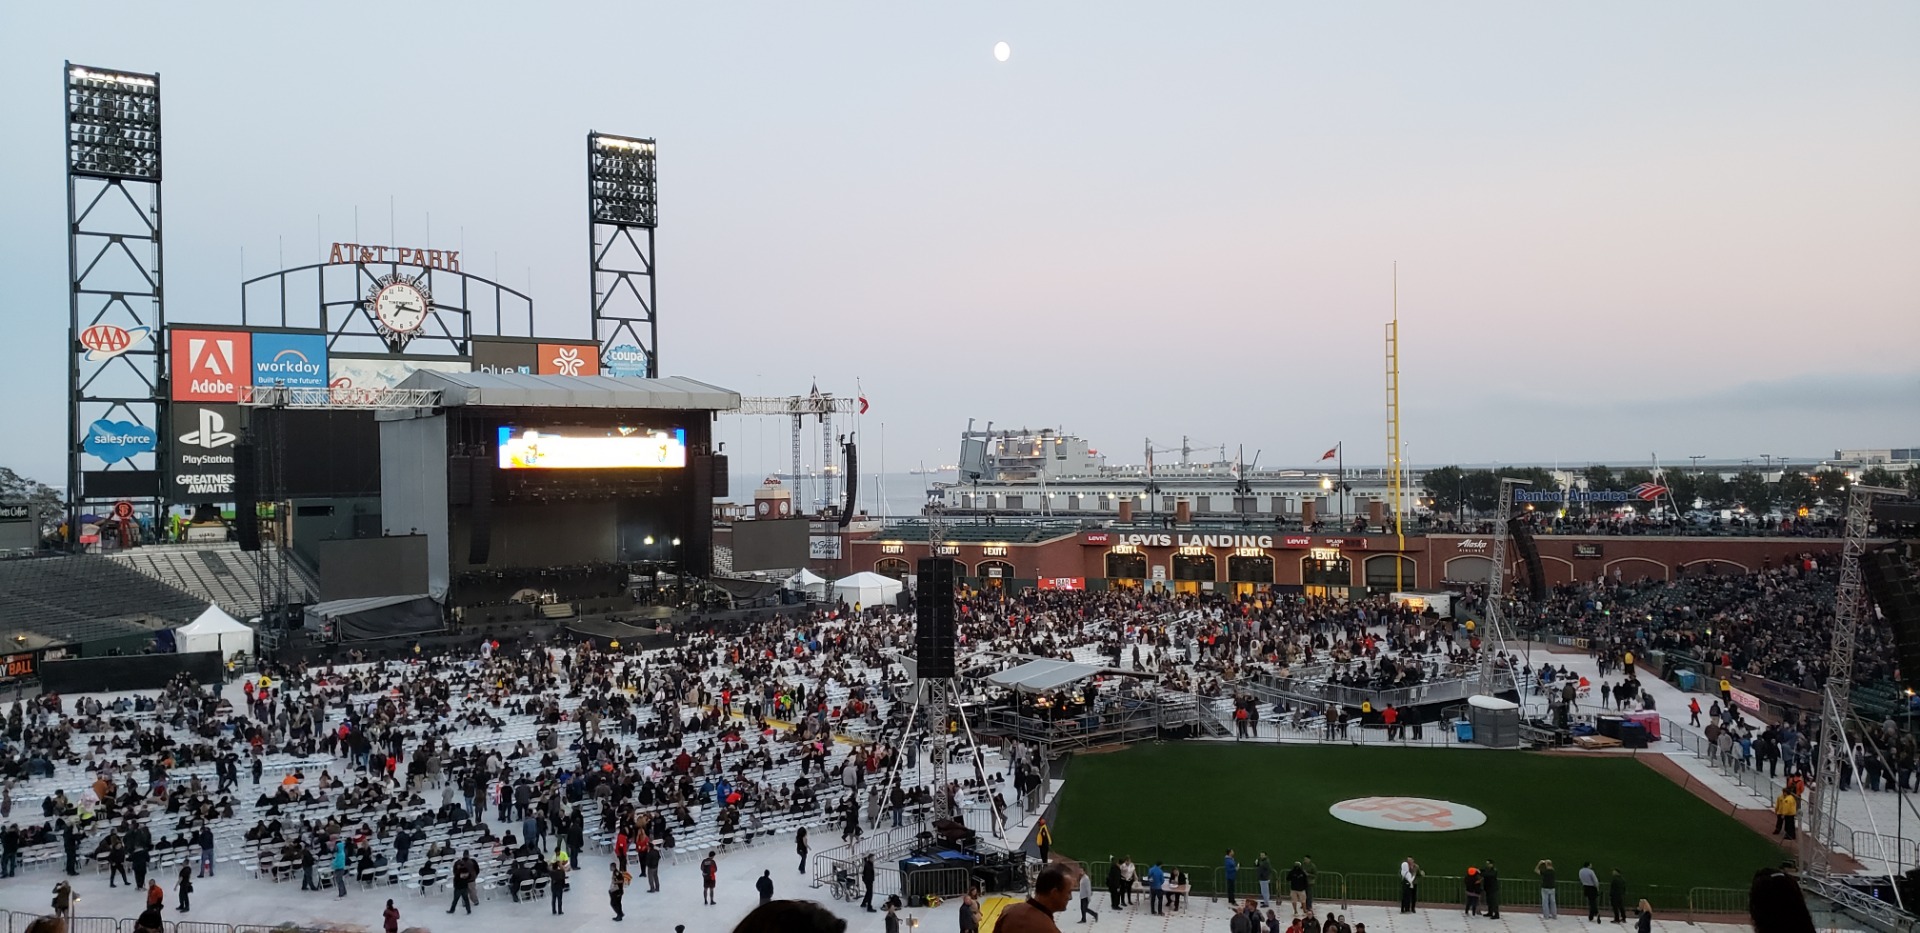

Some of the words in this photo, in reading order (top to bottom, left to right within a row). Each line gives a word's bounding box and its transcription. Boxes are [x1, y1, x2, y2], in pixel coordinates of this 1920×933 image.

[329, 242, 388, 265] AT&T
[397, 247, 460, 273] PARK
[87, 326, 126, 350] AAA
[612, 351, 644, 364] coupa
[257, 361, 320, 375] workday
[480, 363, 514, 374] blue
[190, 379, 233, 393] Adobe
[94, 434, 150, 446] salesforce
[182, 455, 233, 466] PlayStation
[176, 474, 235, 485] GREATNES
[1514, 488, 1550, 501] Bank
[1569, 488, 1627, 501] America
[1178, 534, 1273, 548] LANDING
[1457, 539, 1488, 549] Alaska
[886, 545, 900, 554] EXIT
[941, 546, 955, 555] EXIT
[987, 546, 1003, 556] EXIT
[1116, 544, 1133, 554] EXIT
[1184, 545, 1202, 555] EXIT
[1240, 548, 1260, 557] EXIT
[1315, 551, 1336, 560] EXIT
[1056, 578, 1070, 588] BAR
[8, 660, 33, 676] BALL
